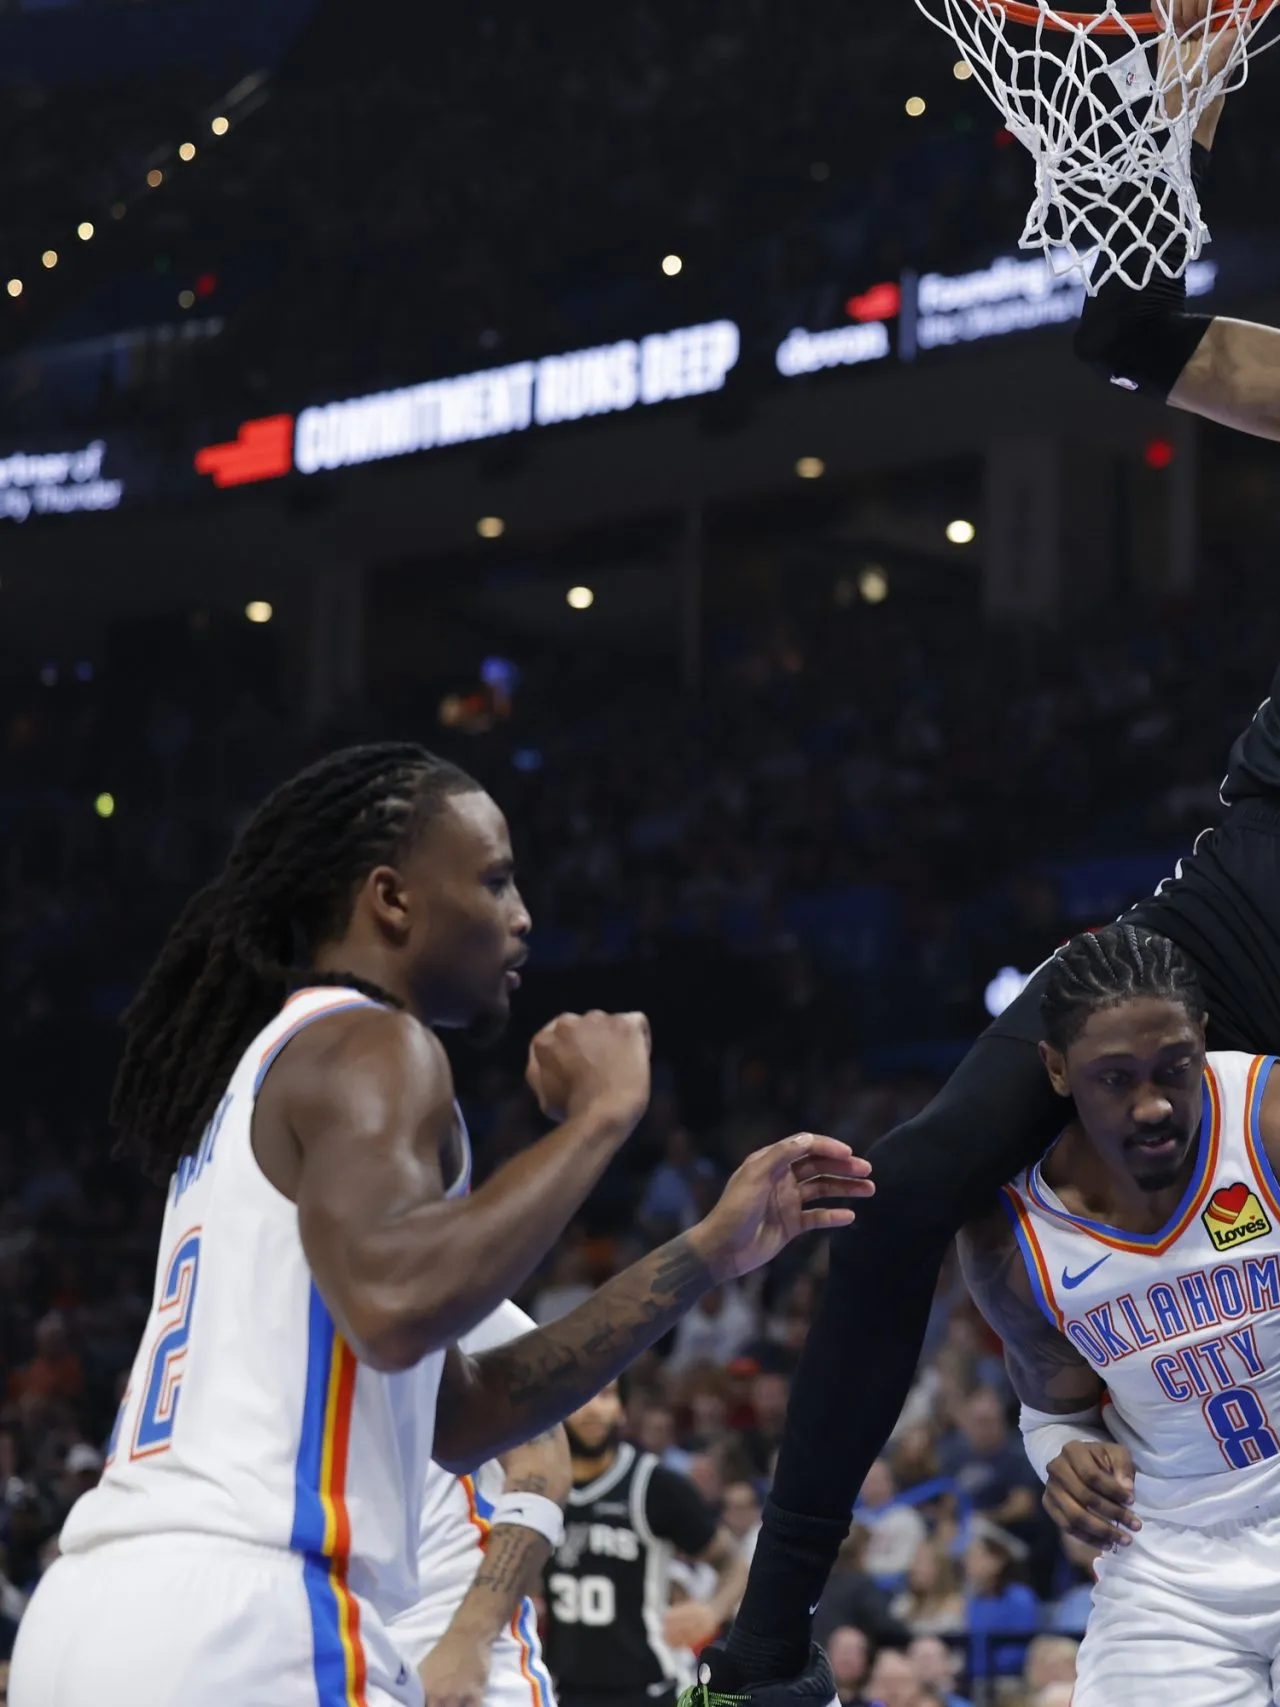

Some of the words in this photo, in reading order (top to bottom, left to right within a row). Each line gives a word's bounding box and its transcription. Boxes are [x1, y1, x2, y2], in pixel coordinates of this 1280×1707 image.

[536, 339, 640, 425] RUNS
[641, 319, 740, 404] DEEP
[104, 1225, 203, 1470] 2
[1151, 1323, 1266, 1402] CITY
[549, 1572, 616, 1627] 30
